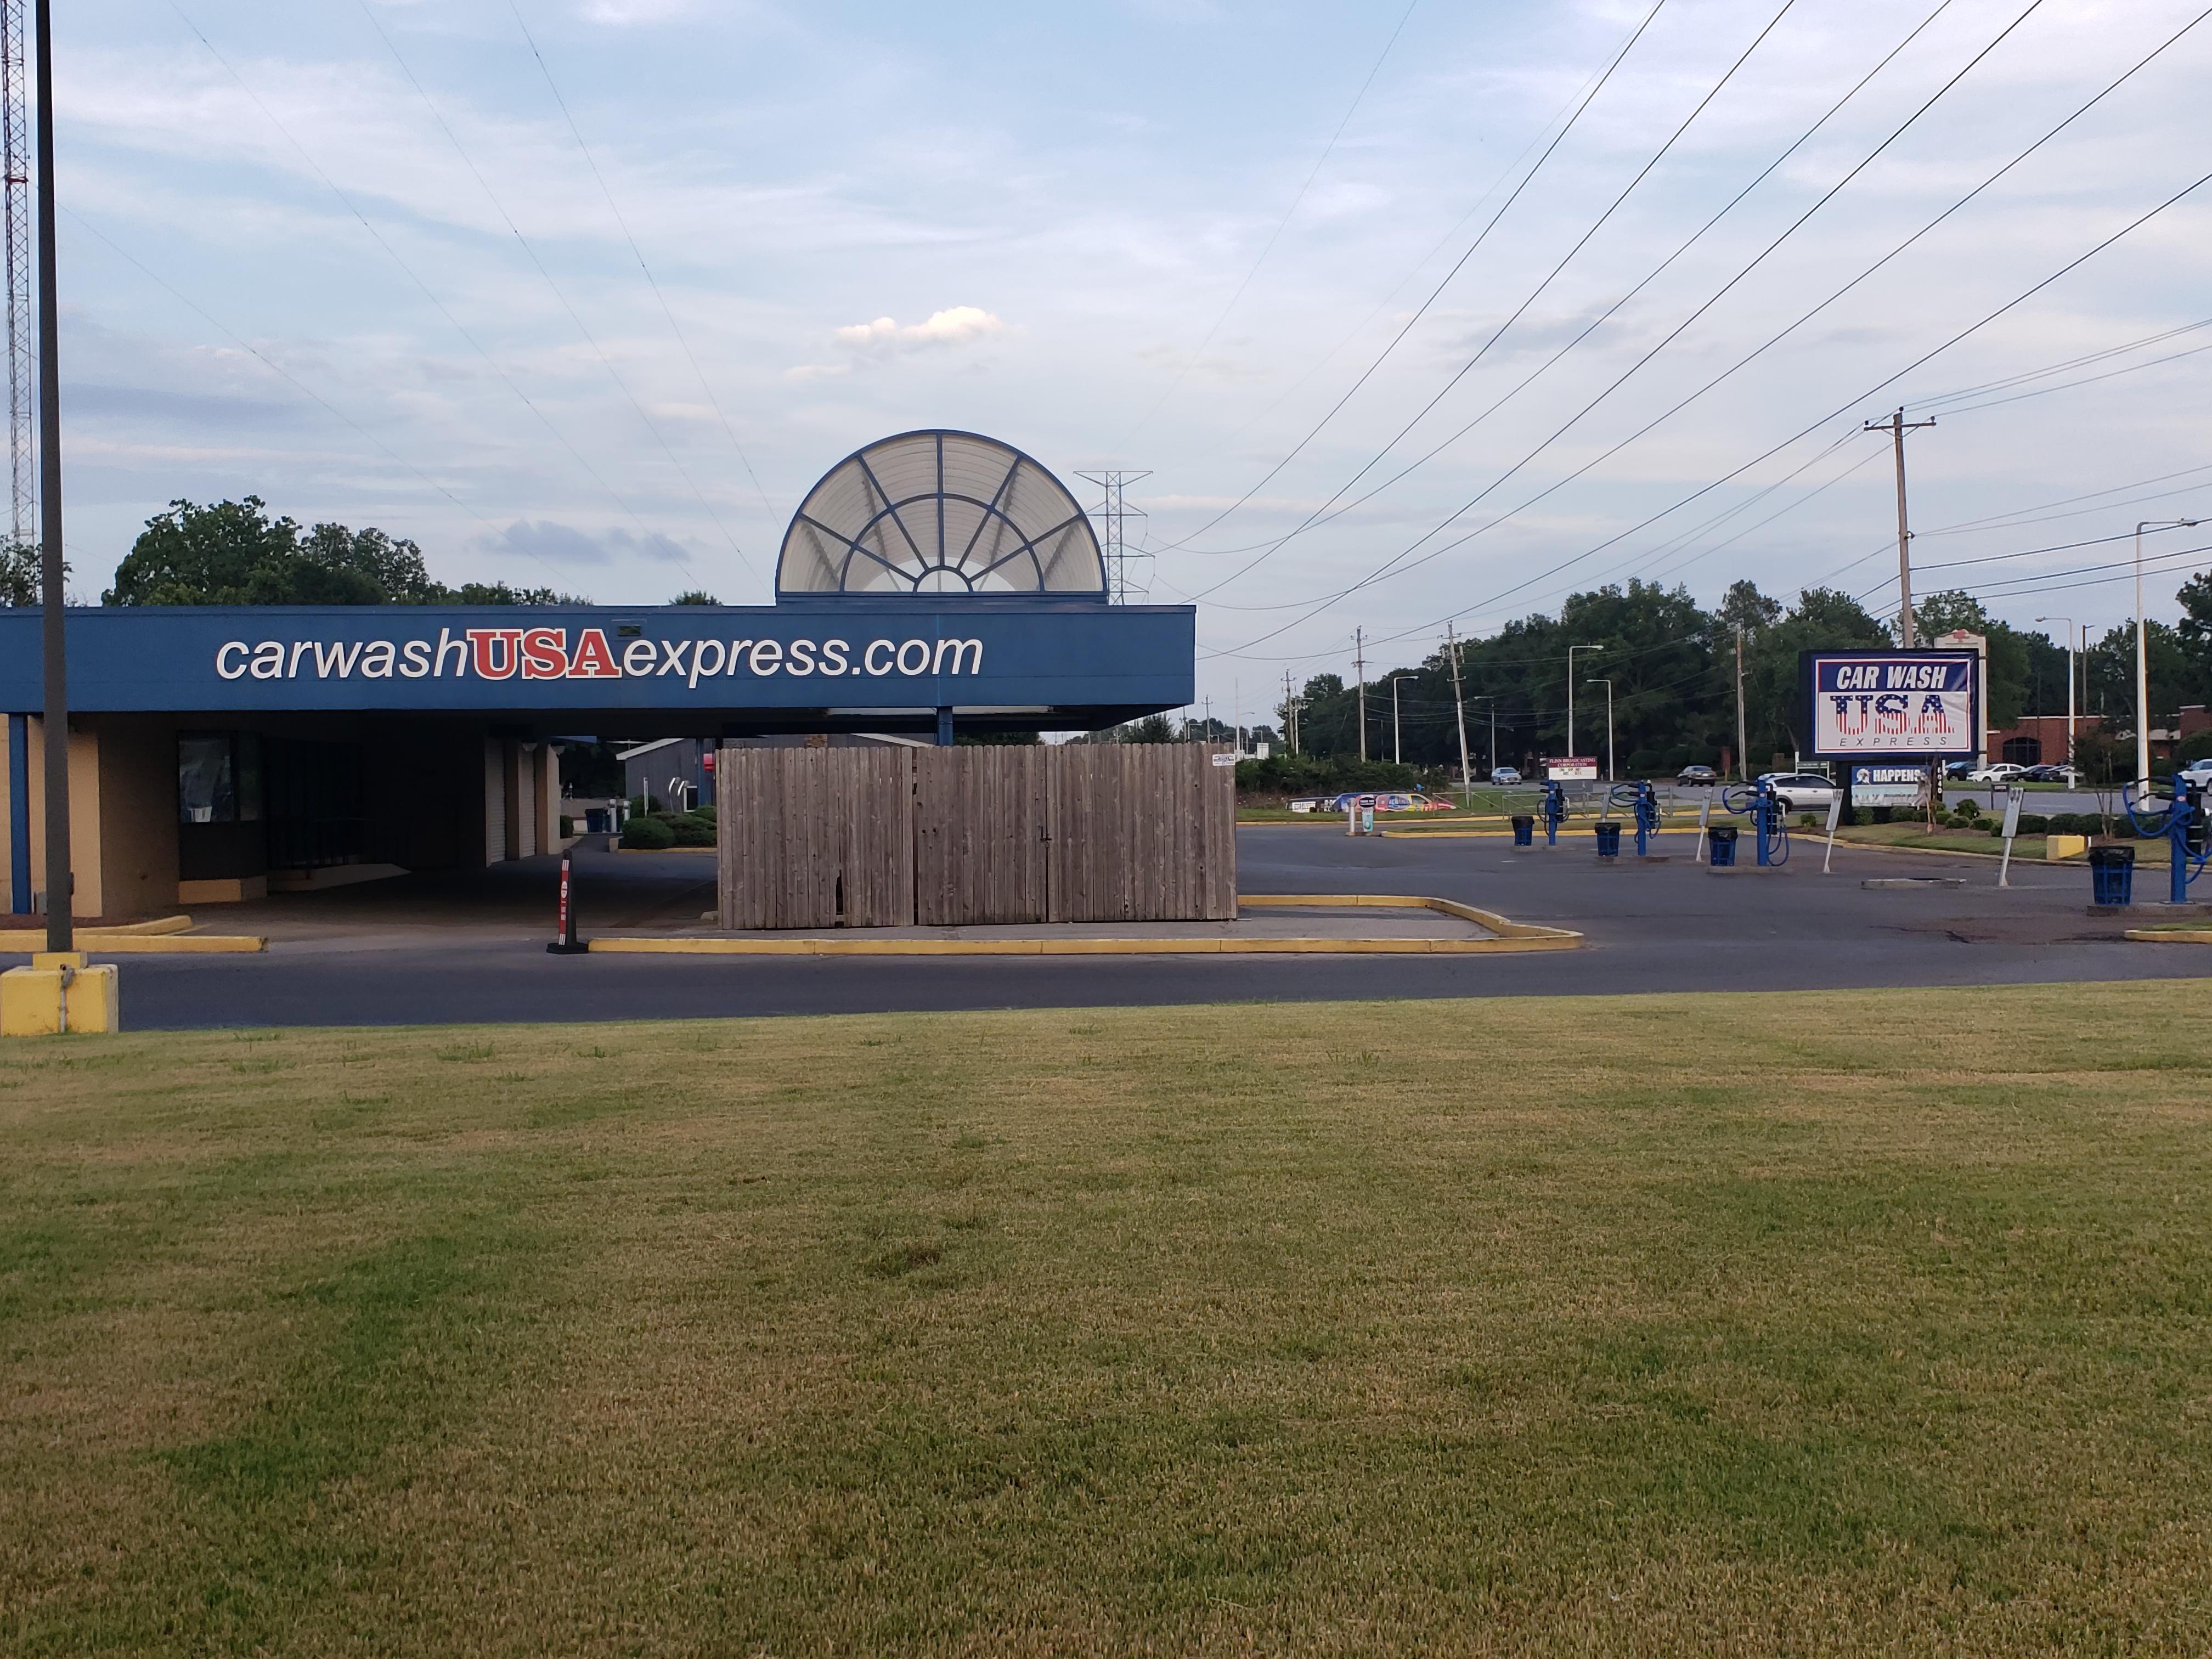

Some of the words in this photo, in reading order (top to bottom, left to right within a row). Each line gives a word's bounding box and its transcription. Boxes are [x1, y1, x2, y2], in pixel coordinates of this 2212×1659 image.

[216, 627, 984, 689] carwashUSAexpress.com
[1836, 665, 1880, 690] CAR
[1886, 665, 1947, 689] WASH
[1830, 693, 1955, 736] USA
[1839, 736, 1947, 747] EXPRESS
[1872, 769, 1921, 782] HAPPENS
